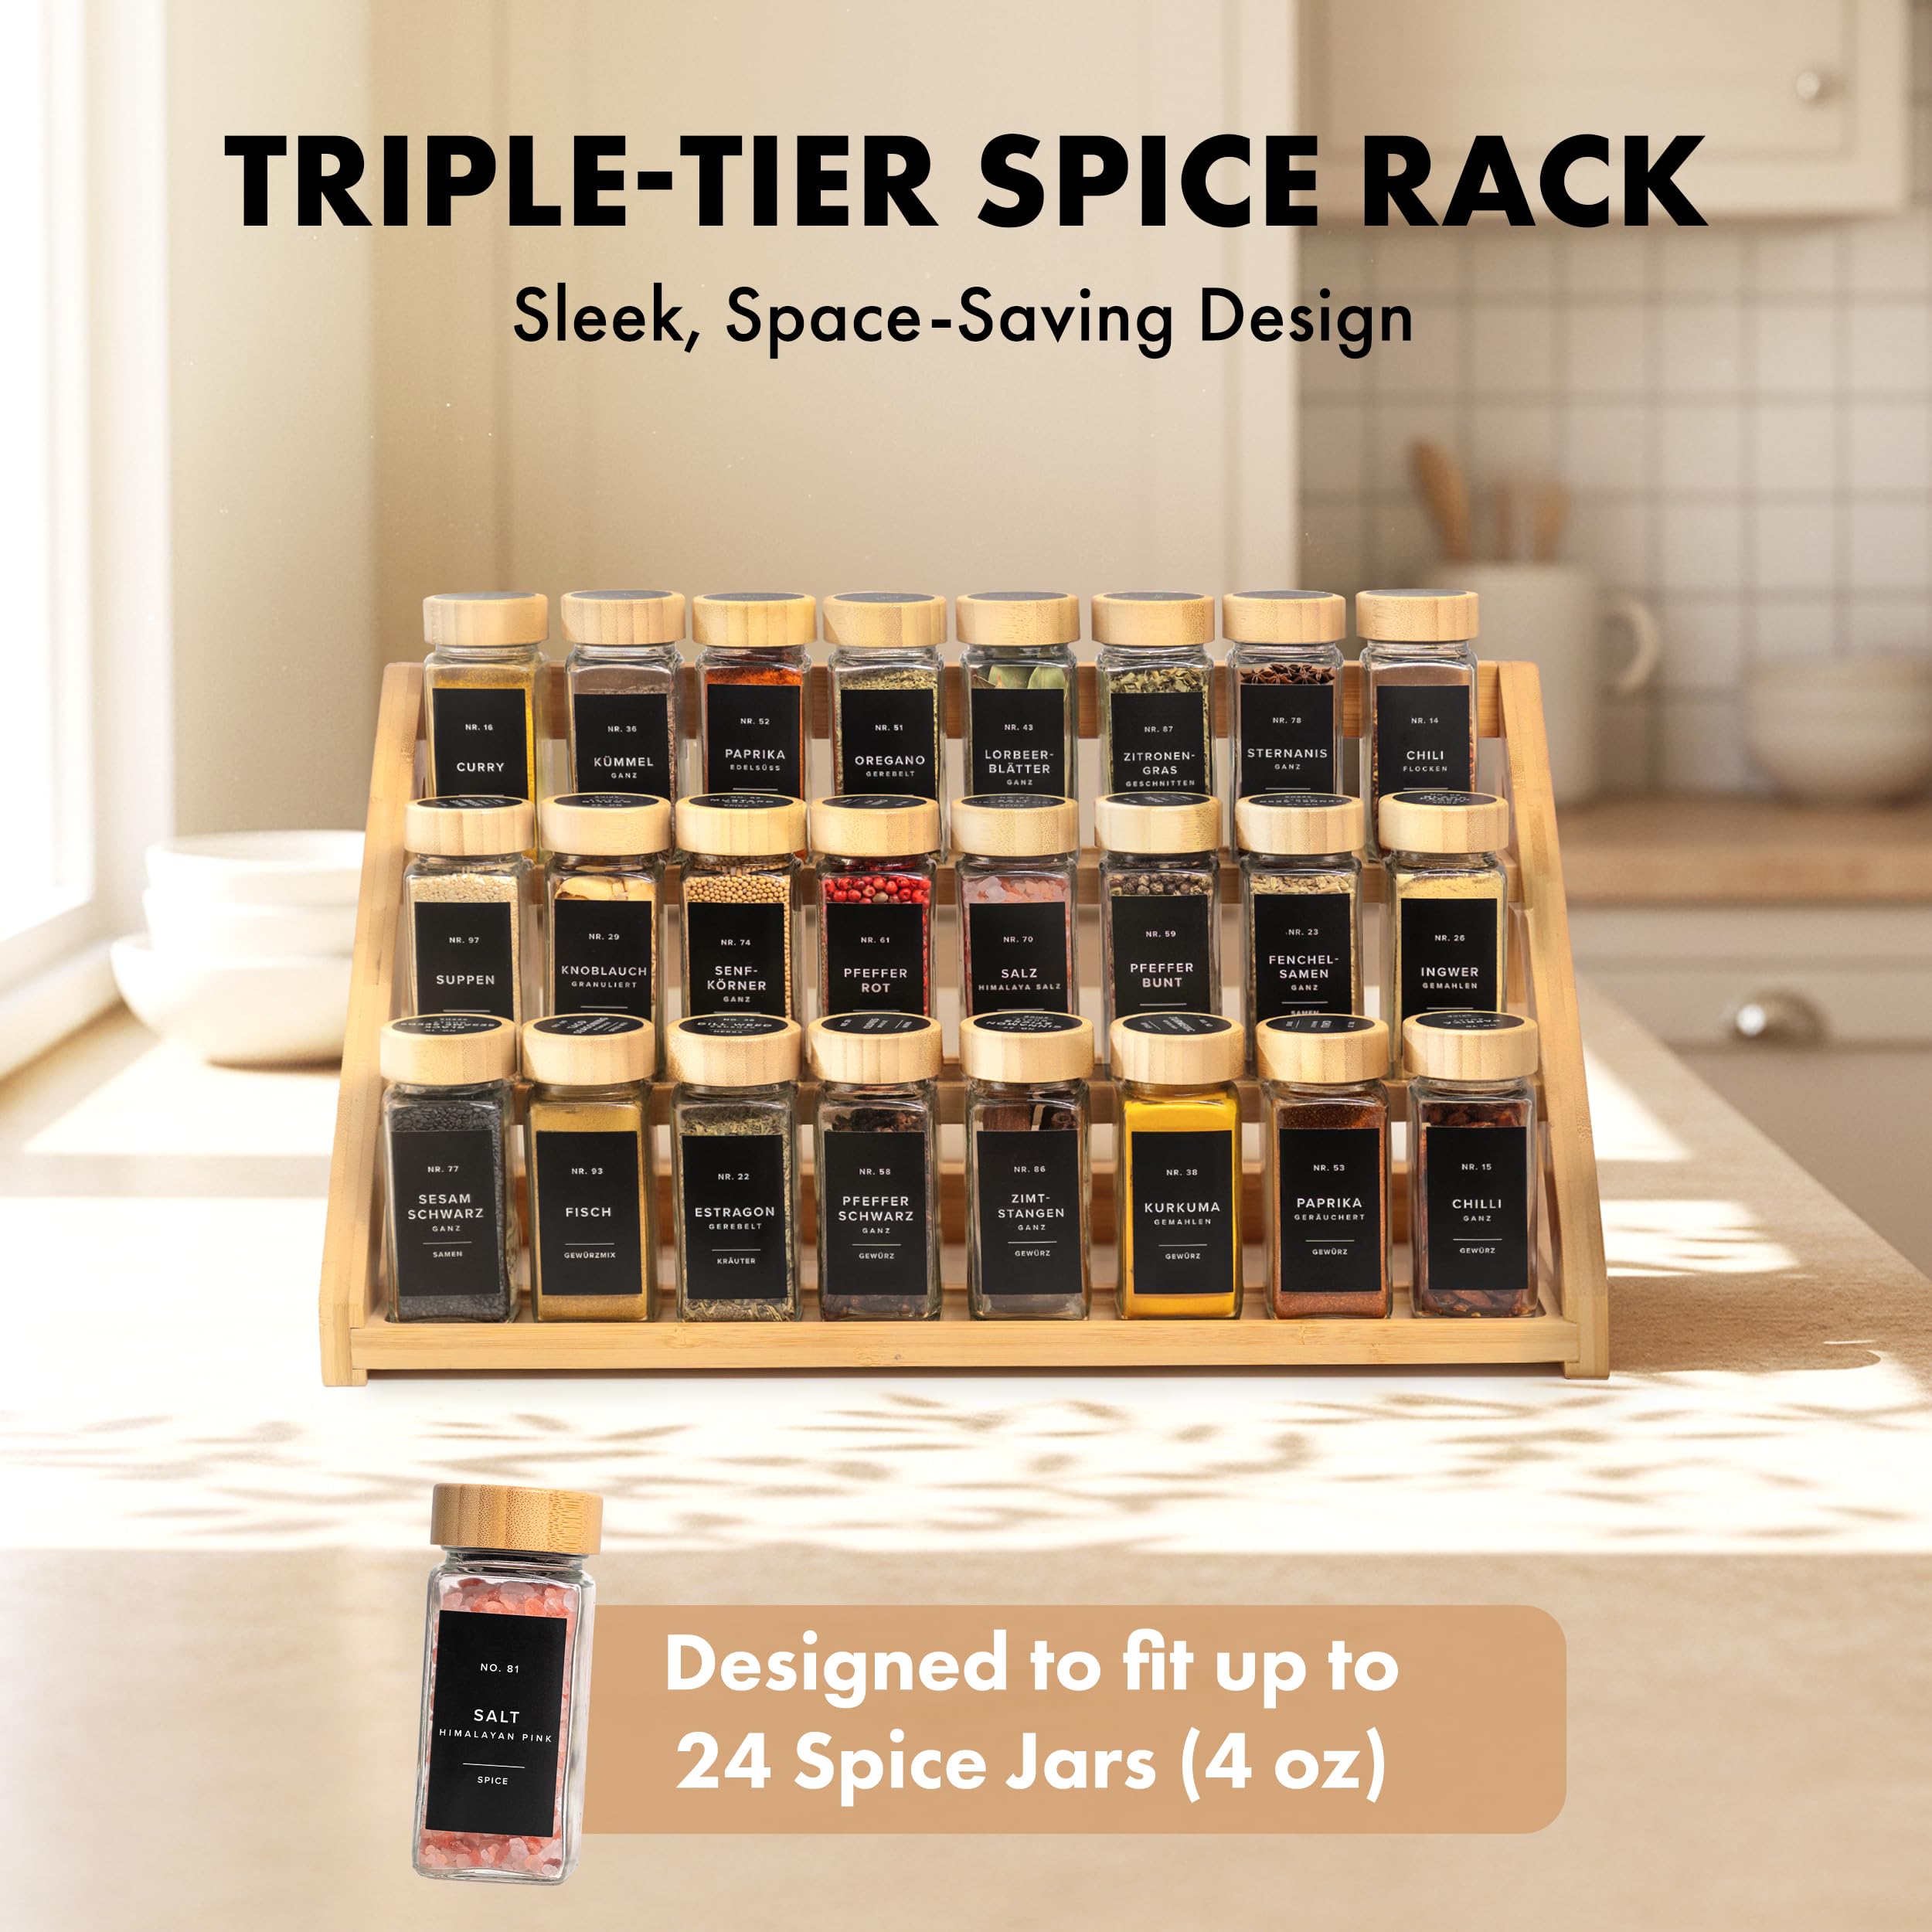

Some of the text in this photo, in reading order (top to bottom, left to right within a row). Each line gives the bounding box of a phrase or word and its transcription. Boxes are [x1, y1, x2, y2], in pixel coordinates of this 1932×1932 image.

[725, 748, 786, 760] PAPRIKA
[985, 750, 1054, 760] LORBEER-
[1123, 751, 1196, 761] ZITRONEN-
[1247, 748, 1328, 758] STERNANIS
[1406, 750, 1444, 760] CHILI
[594, 755, 654, 767] KÜMMEL
[855, 755, 925, 766] OREGANO
[456, 762, 505, 772] CURRY
[988, 762, 1050, 774] BLÄTTER
[1142, 765, 1178, 775] GRAS
[1269, 954, 1339, 965] FENCHEL-
[561, 965, 647, 976] KNOBLAUCH
[715, 965, 758, 976] SENF-
[844, 968, 907, 978] PFEFFER
[1001, 968, 1038, 978] SALZ
[1130, 962, 1193, 973] PFEFFER
[1421, 967, 1479, 978] INGWER
[1279, 968, 1328, 979] SAMEN
[436, 975, 495, 985] SUPPEN
[707, 978, 767, 991] KÖRNER
[1142, 977, 1182, 988] BUNT
[861, 982, 891, 993] ROT
[737, 1172, 750, 1181] 22
[418, 1193, 471, 1205] SESAM
[842, 1196, 909, 1206] PFEFFER
[1011, 1193, 1050, 1203] ZIMT-
[1297, 1197, 1362, 1209] PAPRIKA
[1145, 1202, 1220, 1213] KURKUMA
[1452, 1199, 1502, 1209] CHILLI
[407, 1208, 484, 1220] SCHWARZ
[565, 1206, 611, 1218] FISCH
[695, 1206, 775, 1218] ESTRAGON
[838, 1210, 913, 1222] SCHWARZ
[998, 1208, 1064, 1219] STANGEN
[1311, 1247, 1348, 1256] GEWÜRZ
[716, 1257, 756, 1265] KRÄUTER
[480, 1662, 519, 1674] NO. 81
[473, 1709, 520, 1724] SALT
[439, 1728, 552, 1743] HIMALAYAN PINK
[477, 1776, 509, 1785] SPICE
